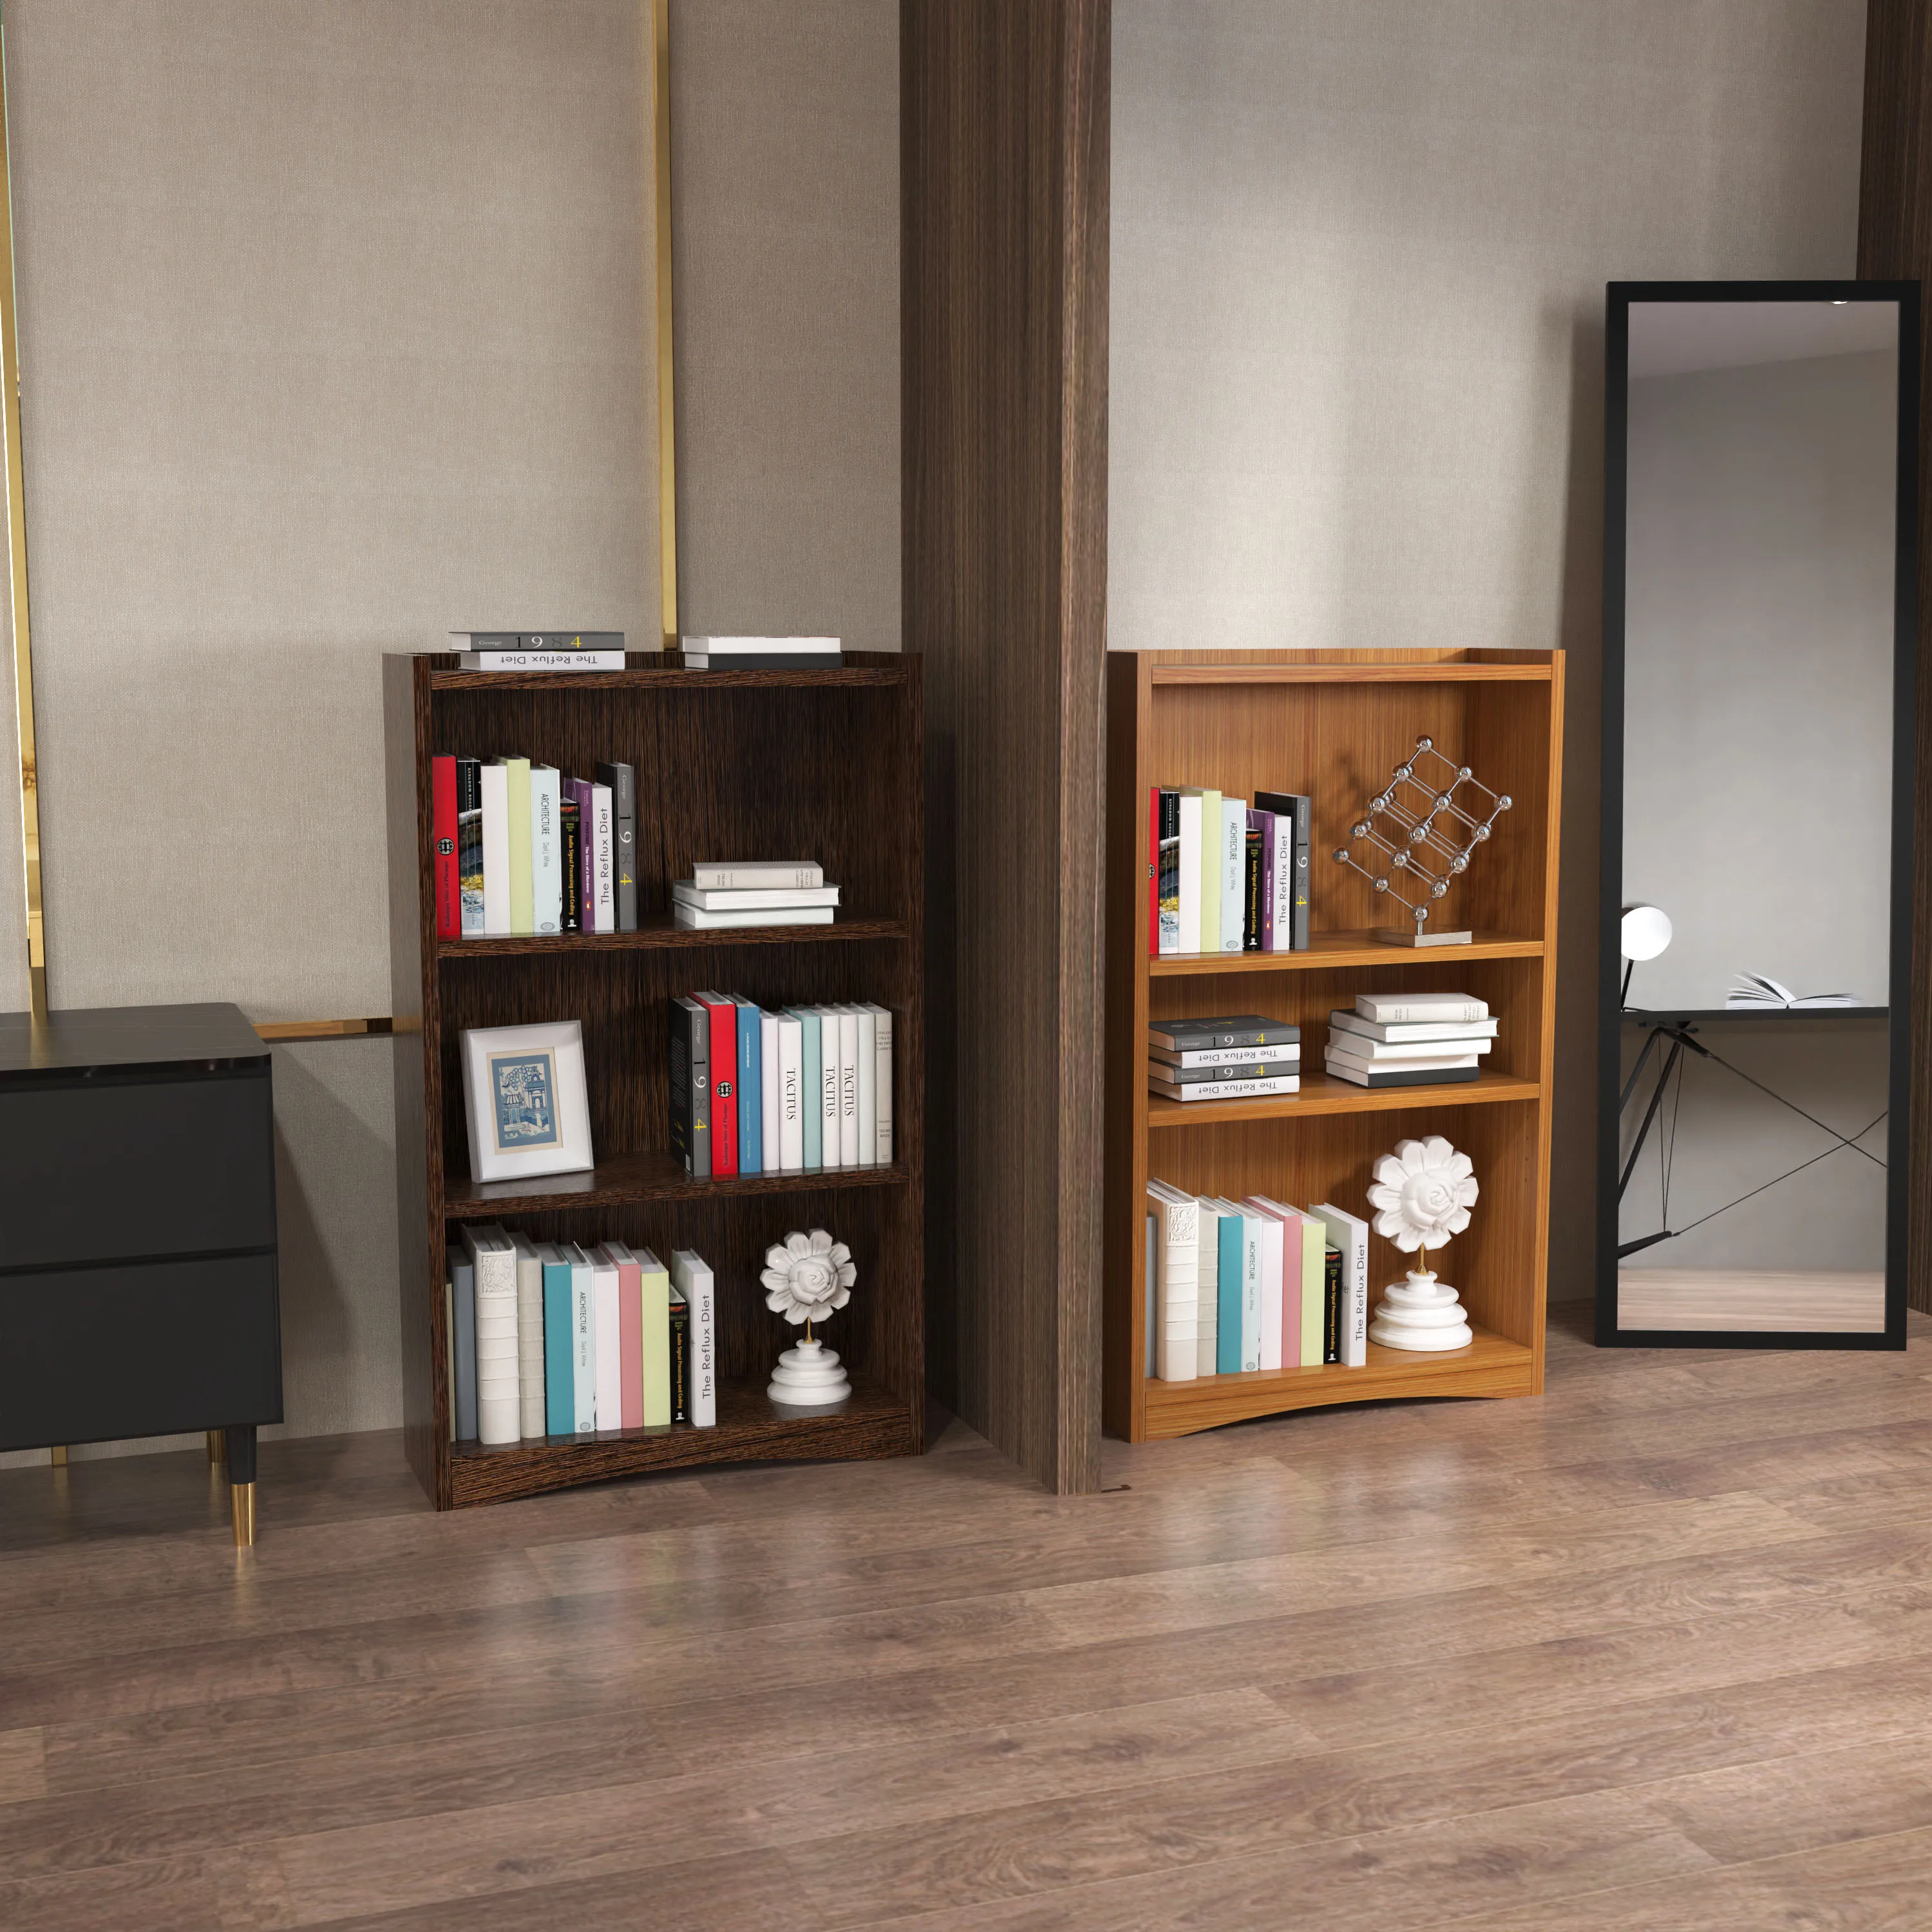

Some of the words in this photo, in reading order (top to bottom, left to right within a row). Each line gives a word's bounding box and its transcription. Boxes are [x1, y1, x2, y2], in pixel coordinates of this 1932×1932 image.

[500, 656, 526, 665] Diet
[532, 656, 571, 665] Reflux
[576, 656, 598, 664] The
[541, 793, 550, 835] ARCHITECTURE
[600, 808, 609, 834] Diet
[600, 838, 609, 878] Reflux
[600, 883, 609, 905] The
[1279, 864, 1287, 900] Reflux
[1224, 1051, 1256, 1060] Reflux
[786, 1068, 796, 1120] TACITUS
[826, 1066, 835, 1117] TACITUS
[844, 1065, 854, 1116] TACITUS
[1224, 1083, 1255, 1092] Reflux
[1357, 1244, 1365, 1269] Diet
[701, 1294, 710, 1323] Diet
[702, 1328, 710, 1370] Reflux
[702, 1375, 711, 1399] The
